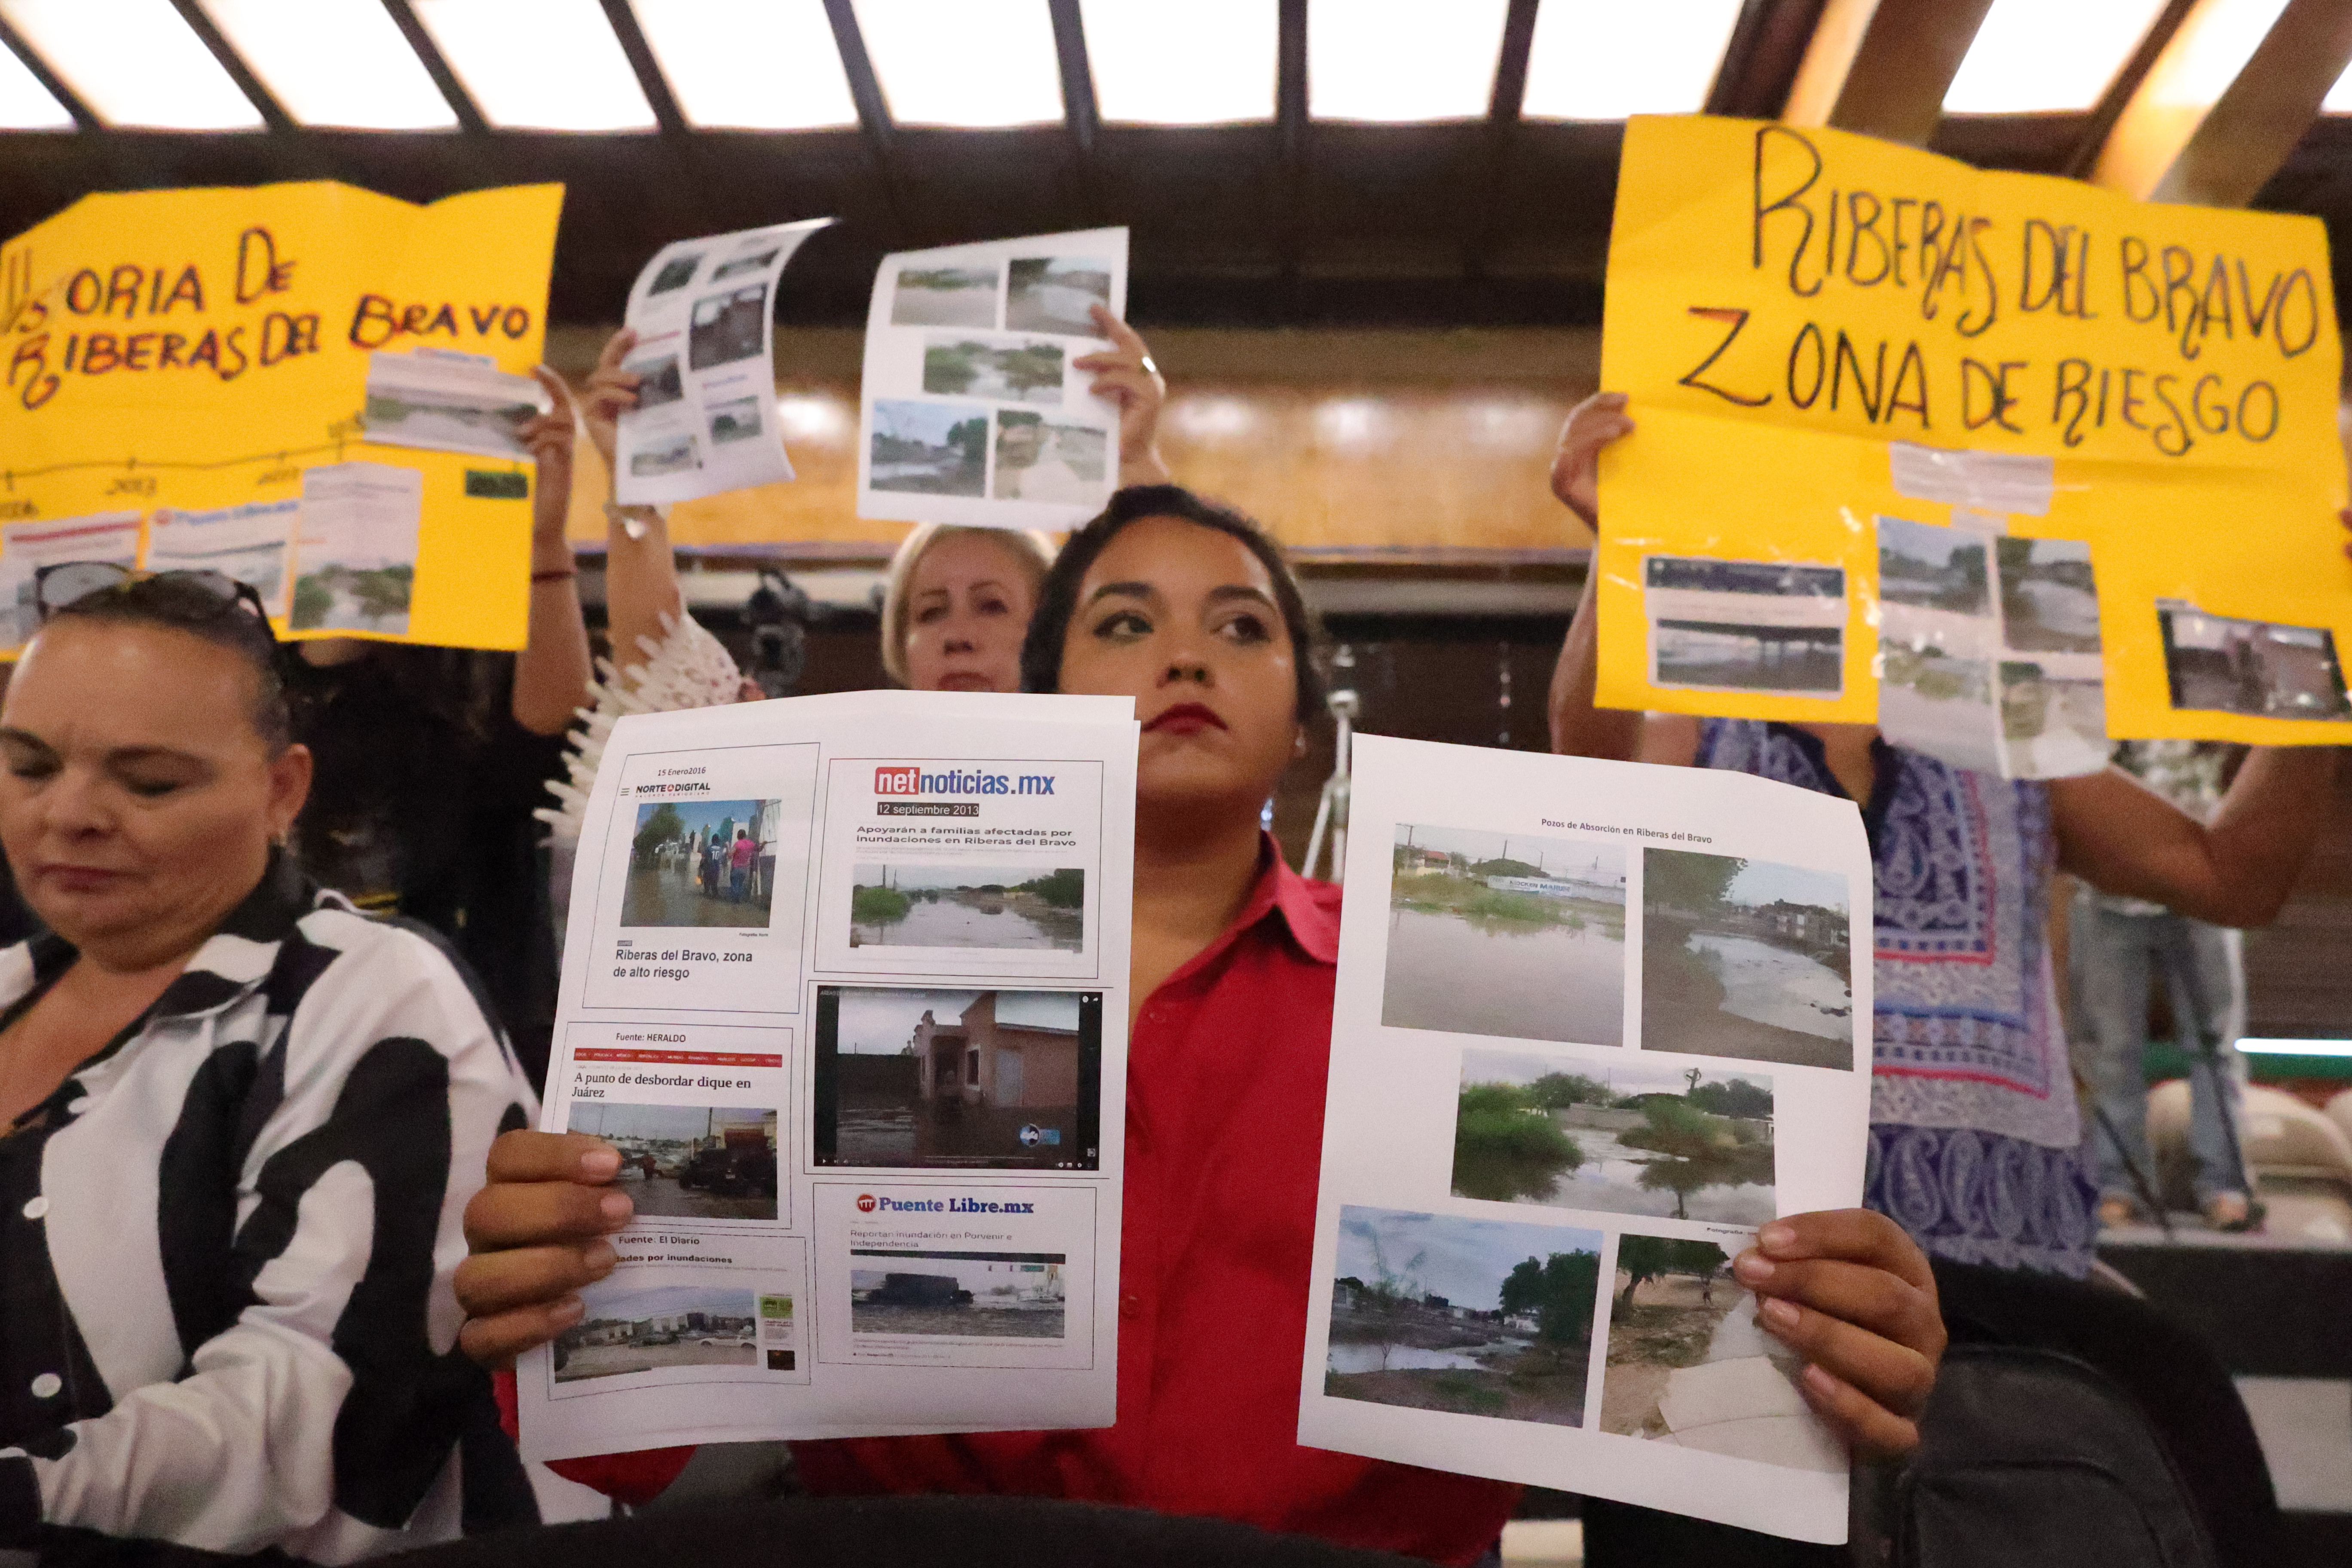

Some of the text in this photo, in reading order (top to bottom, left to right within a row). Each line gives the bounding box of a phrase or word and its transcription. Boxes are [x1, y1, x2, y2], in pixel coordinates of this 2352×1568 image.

[1753, 125, 2320, 360] RIBERAS DEL BRAVO
[7, 327, 248, 410] RIBERAS
[1678, 306, 2278, 456] ZONA DE RIESGO
[668, 767, 706, 775] Enero2016
[636, 783, 710, 793] NORTE DIGITAL
[877, 769, 1056, 795] netnoticias.mx
[878, 804, 979, 816] 12 septiembre 2013
[857, 826, 916, 835] Apoyarán
[931, 827, 980, 835] familias
[984, 828, 1047, 836] afectadas
[1542, 819, 1565, 828] Pozos
[1580, 823, 1620, 834] Absorción
[1637, 828, 1669, 839] Riberas
[1672, 831, 1684, 840] del
[1687, 834, 1712, 844] Bravo
[616, 949, 752, 962] Riberas del Bravo, zona
[613, 967, 689, 980] de alto riesgo
[647, 1034, 686, 1042] HERALDO
[574, 1072, 751, 1090] A punto de desbordar dique en
[572, 1087, 604, 1097] Juárez
[879, 1197, 1034, 1213] Puente Libre.mx
[850, 1230, 894, 1238] Reportan
[965, 1232, 1004, 1240] Porvenir
[850, 1240, 919, 1248] Independencia
[668, 1254, 732, 1263] inundaciones
